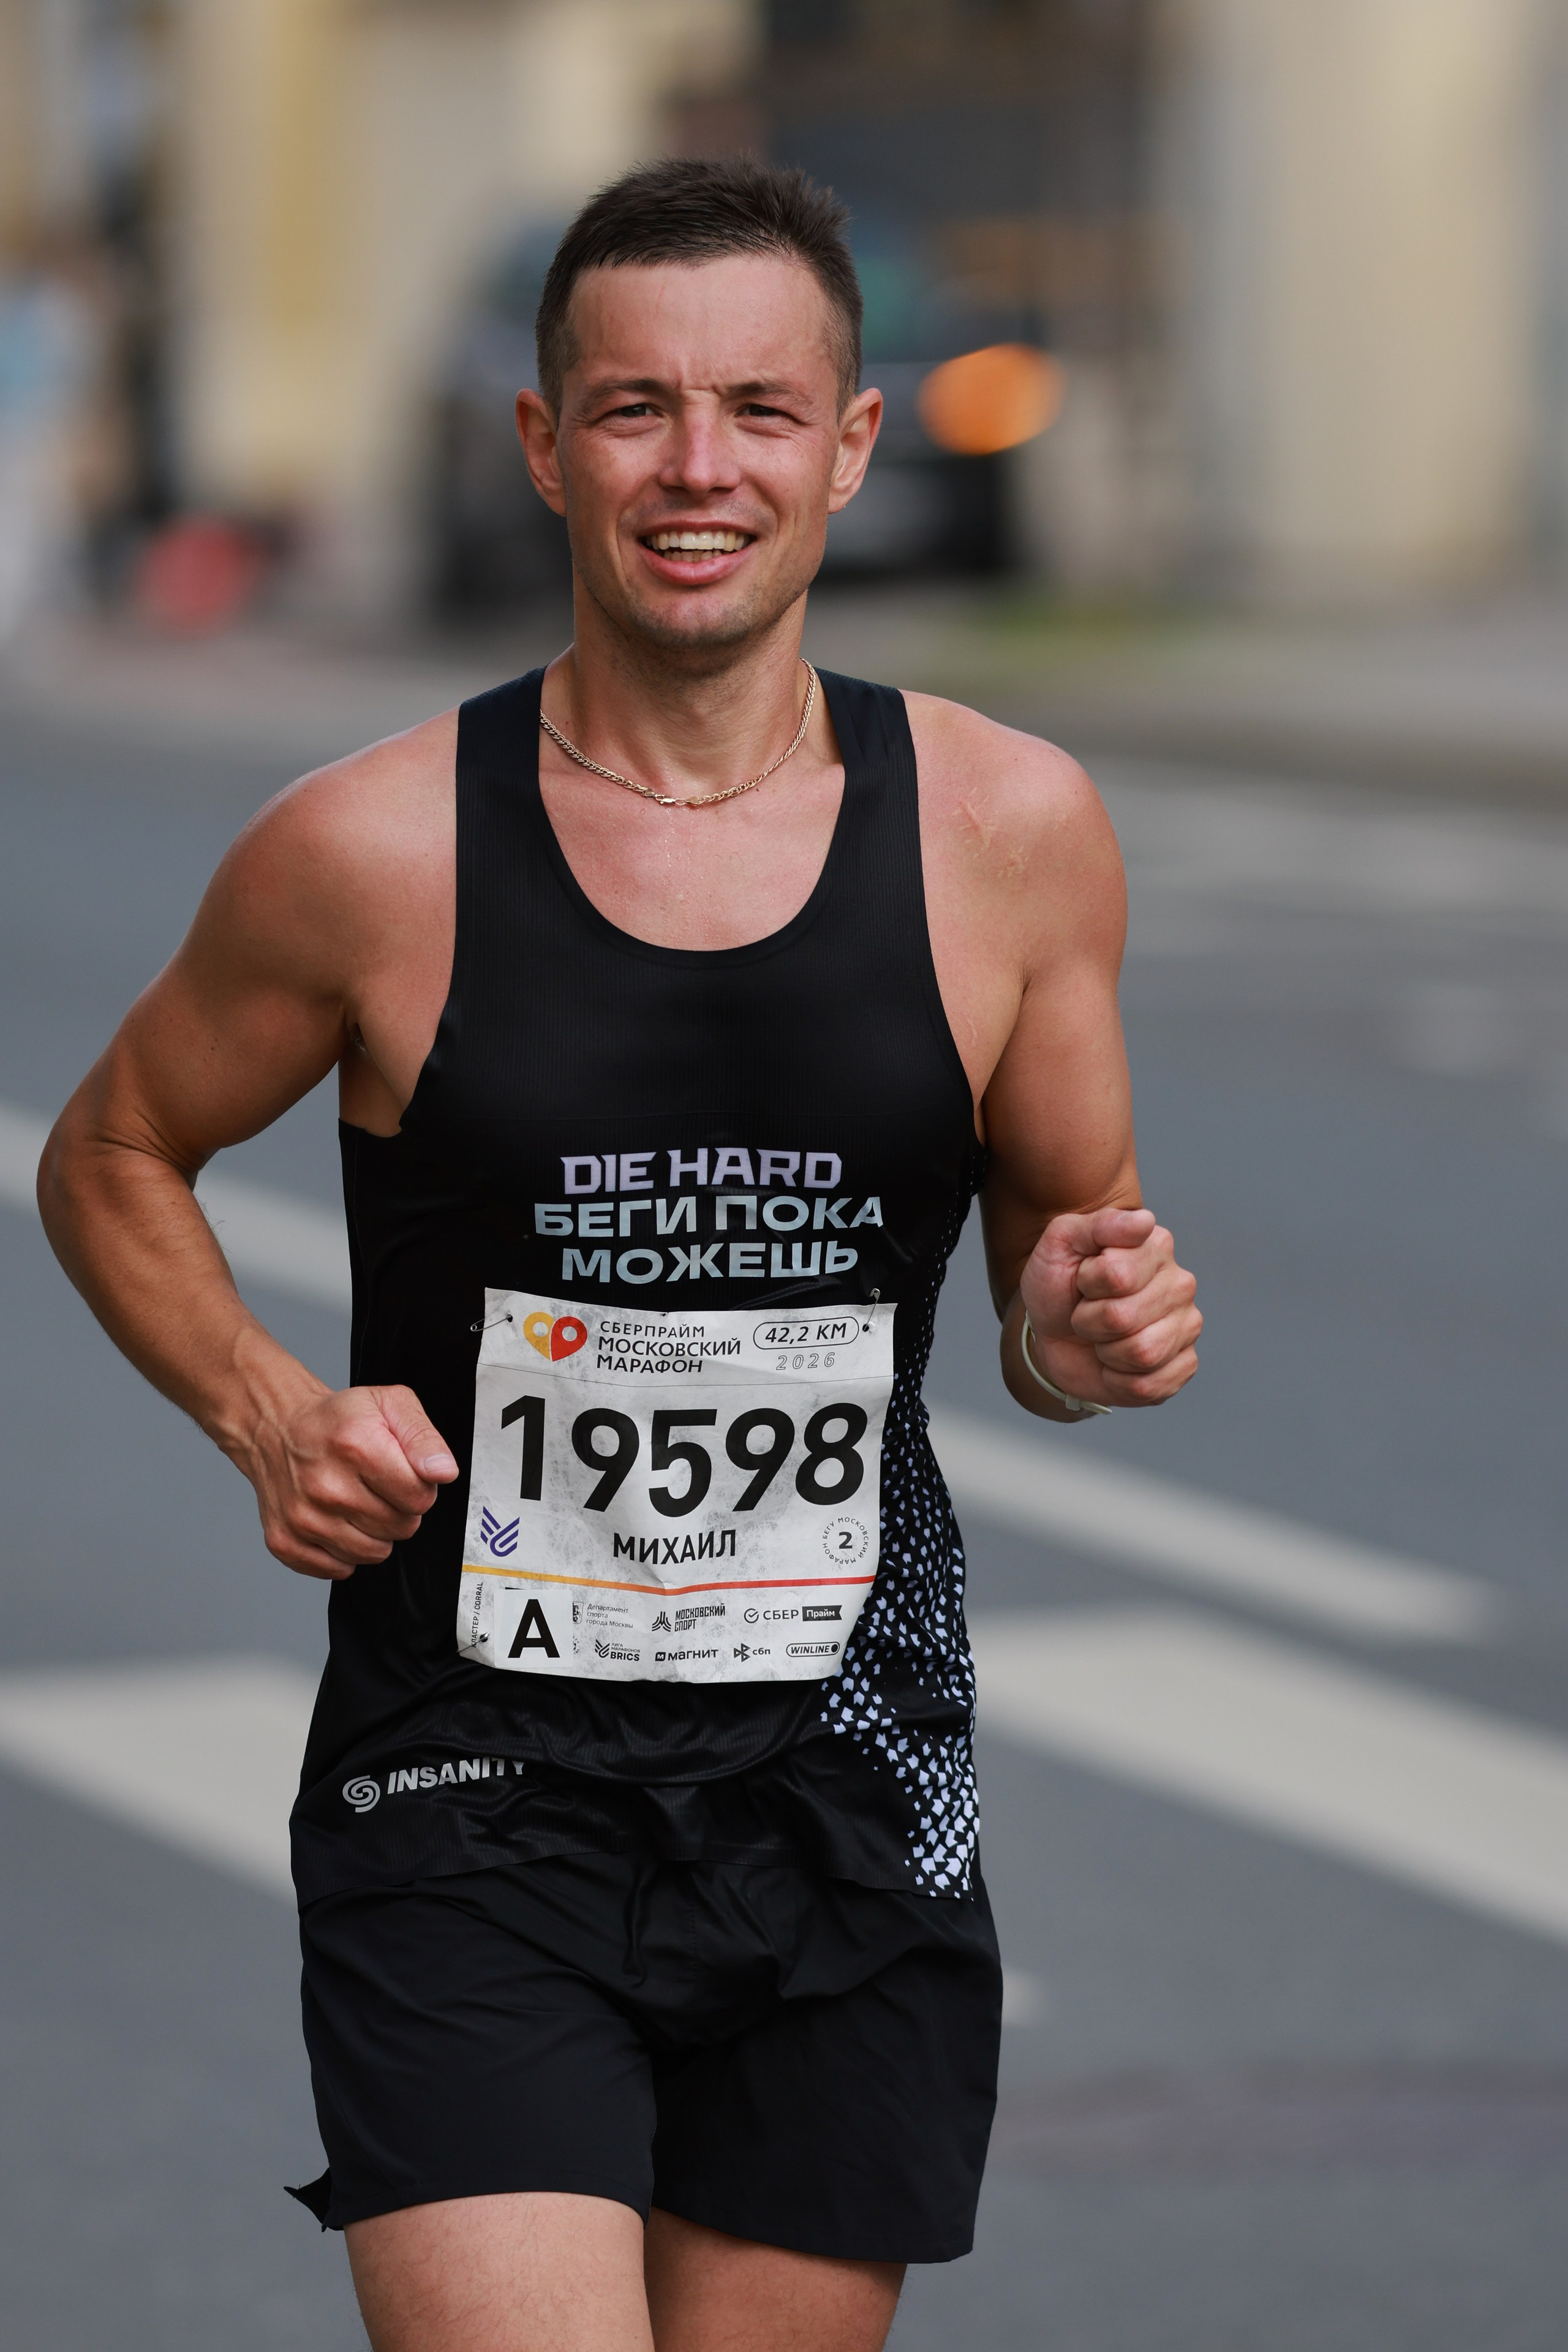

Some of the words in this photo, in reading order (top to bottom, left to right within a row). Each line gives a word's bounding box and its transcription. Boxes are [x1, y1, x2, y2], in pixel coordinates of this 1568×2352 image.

[560, 1152, 657, 1194] DIE
[666, 1147, 842, 1189] HARD
[534, 1196, 696, 1237] БЕГИ
[715, 1195, 883, 1231] ПОКА
[562, 1240, 858, 1284] МОЖЕШЬ
[600, 1321, 704, 1338] СБЕРПРАЙМ
[765, 1326, 809, 1344] 42,2
[598, 1336, 741, 1357] МОСКОВСКИЙ
[597, 1354, 703, 1373] МАРАФОН
[776, 1352, 835, 1370] 2026
[501, 1395, 867, 1517] 19598
[823, 1521, 834, 1539] БЕГУ
[838, 1517, 869, 1558] МОСКОВСКИЙ
[613, 1529, 736, 1564] МИХАИЛ
[839, 1531, 853, 1549] 2
[823, 1543, 856, 1564] МАРАФОН
[474, 1582, 483, 1610] CORRAL
[587, 1604, 628, 1613] Департамент
[676, 1603, 725, 1621] МОСКОВСКИЙ
[763, 1610, 799, 1620] СБЕР
[807, 1608, 835, 1618] Прайм
[471, 1616, 480, 1648] КЛАСТЕР
[674, 1619, 696, 1632] СПОРТ
[610, 1651, 640, 1661] BRICS
[791, 1645, 830, 1654] WINLINE
[387, 1756, 525, 1794] INSANITY
